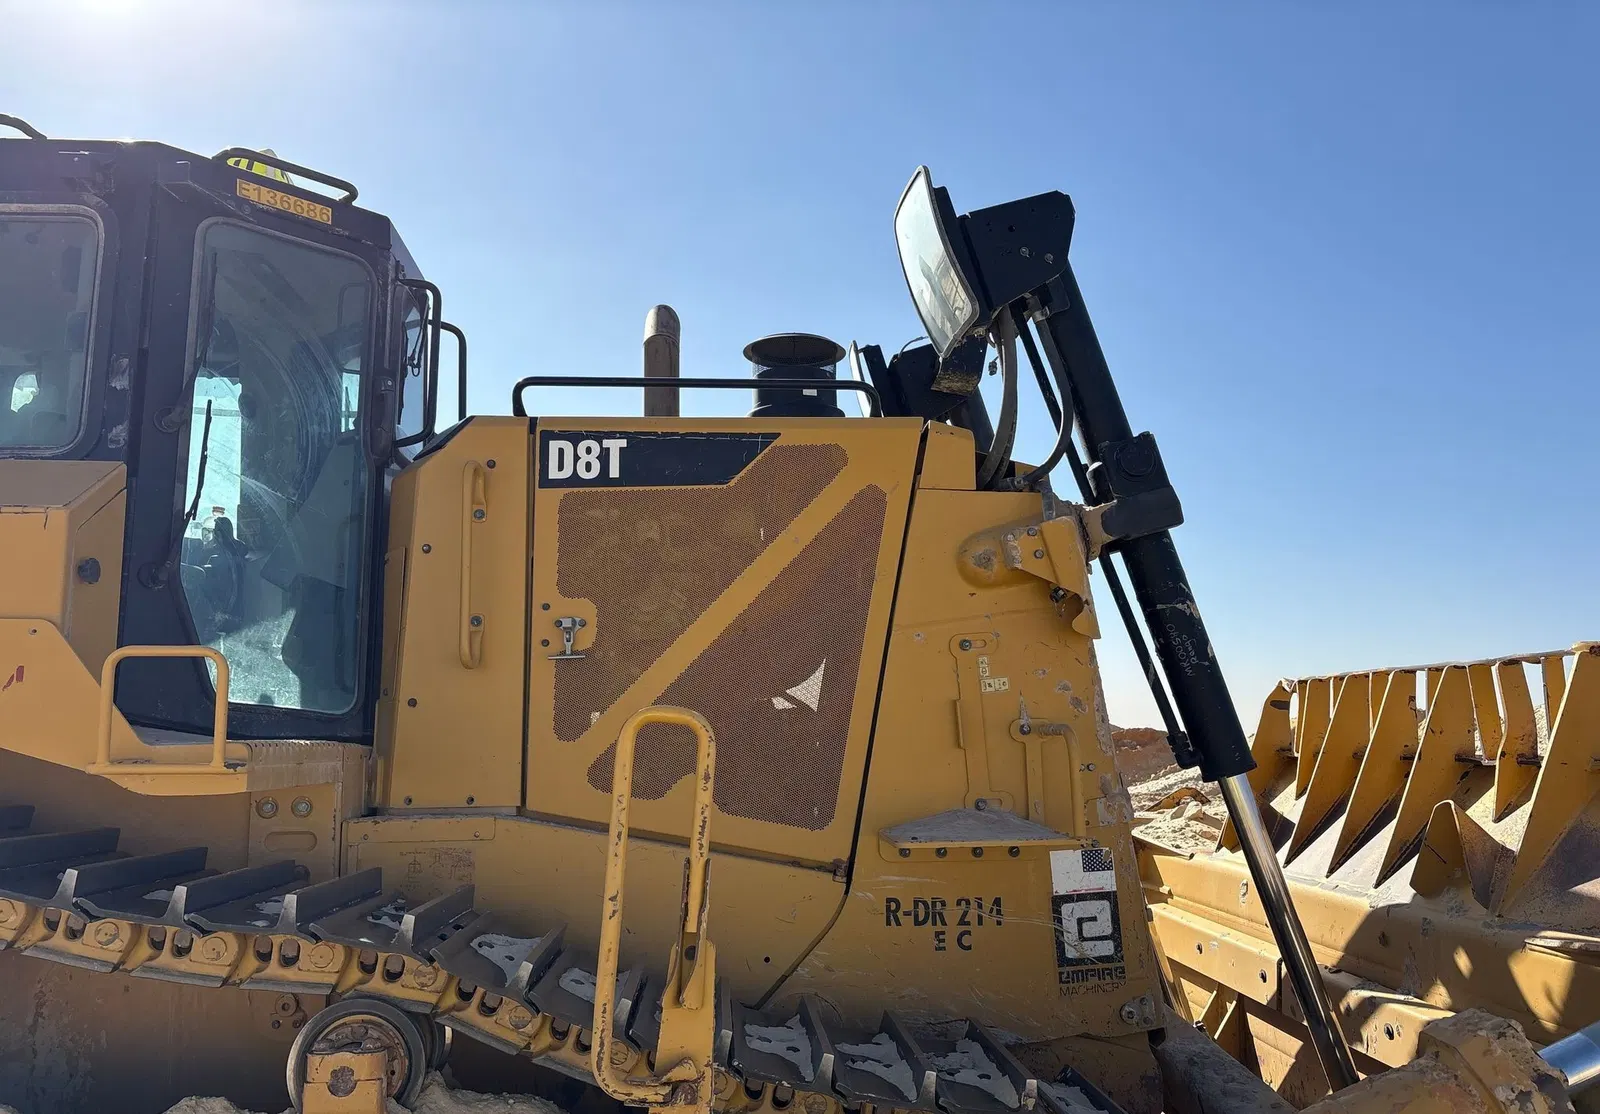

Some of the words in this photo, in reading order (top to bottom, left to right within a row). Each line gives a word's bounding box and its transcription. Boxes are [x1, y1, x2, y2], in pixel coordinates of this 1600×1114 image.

[238, 180, 331, 223] E136686
[548, 438, 627, 480] D8T
[886, 897, 947, 927] R-DR
[956, 897, 1004, 927] 214
[935, 930, 947, 951] E
[957, 930, 972, 951] C
[1060, 981, 1127, 997] MACHINERY
